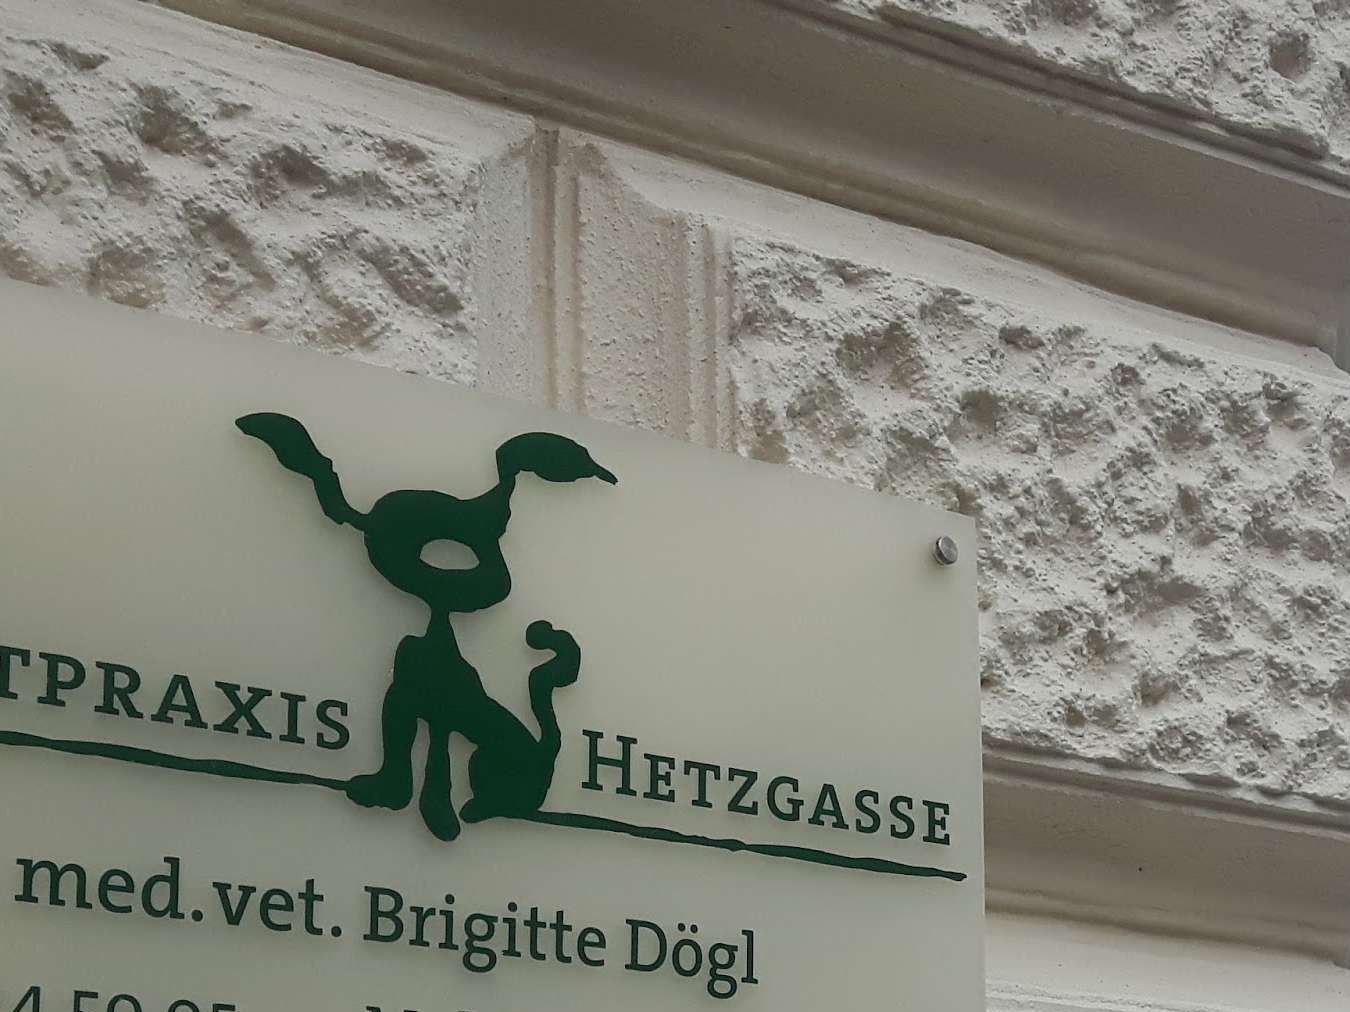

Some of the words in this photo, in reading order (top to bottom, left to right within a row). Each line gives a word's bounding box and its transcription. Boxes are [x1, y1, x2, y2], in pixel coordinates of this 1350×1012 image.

[0, 644, 351, 751] TPRAXIS
[581, 728, 951, 847] HETZGASSE
[362, 885, 607, 974] Brigitte
[624, 918, 759, 1000] Dögl
